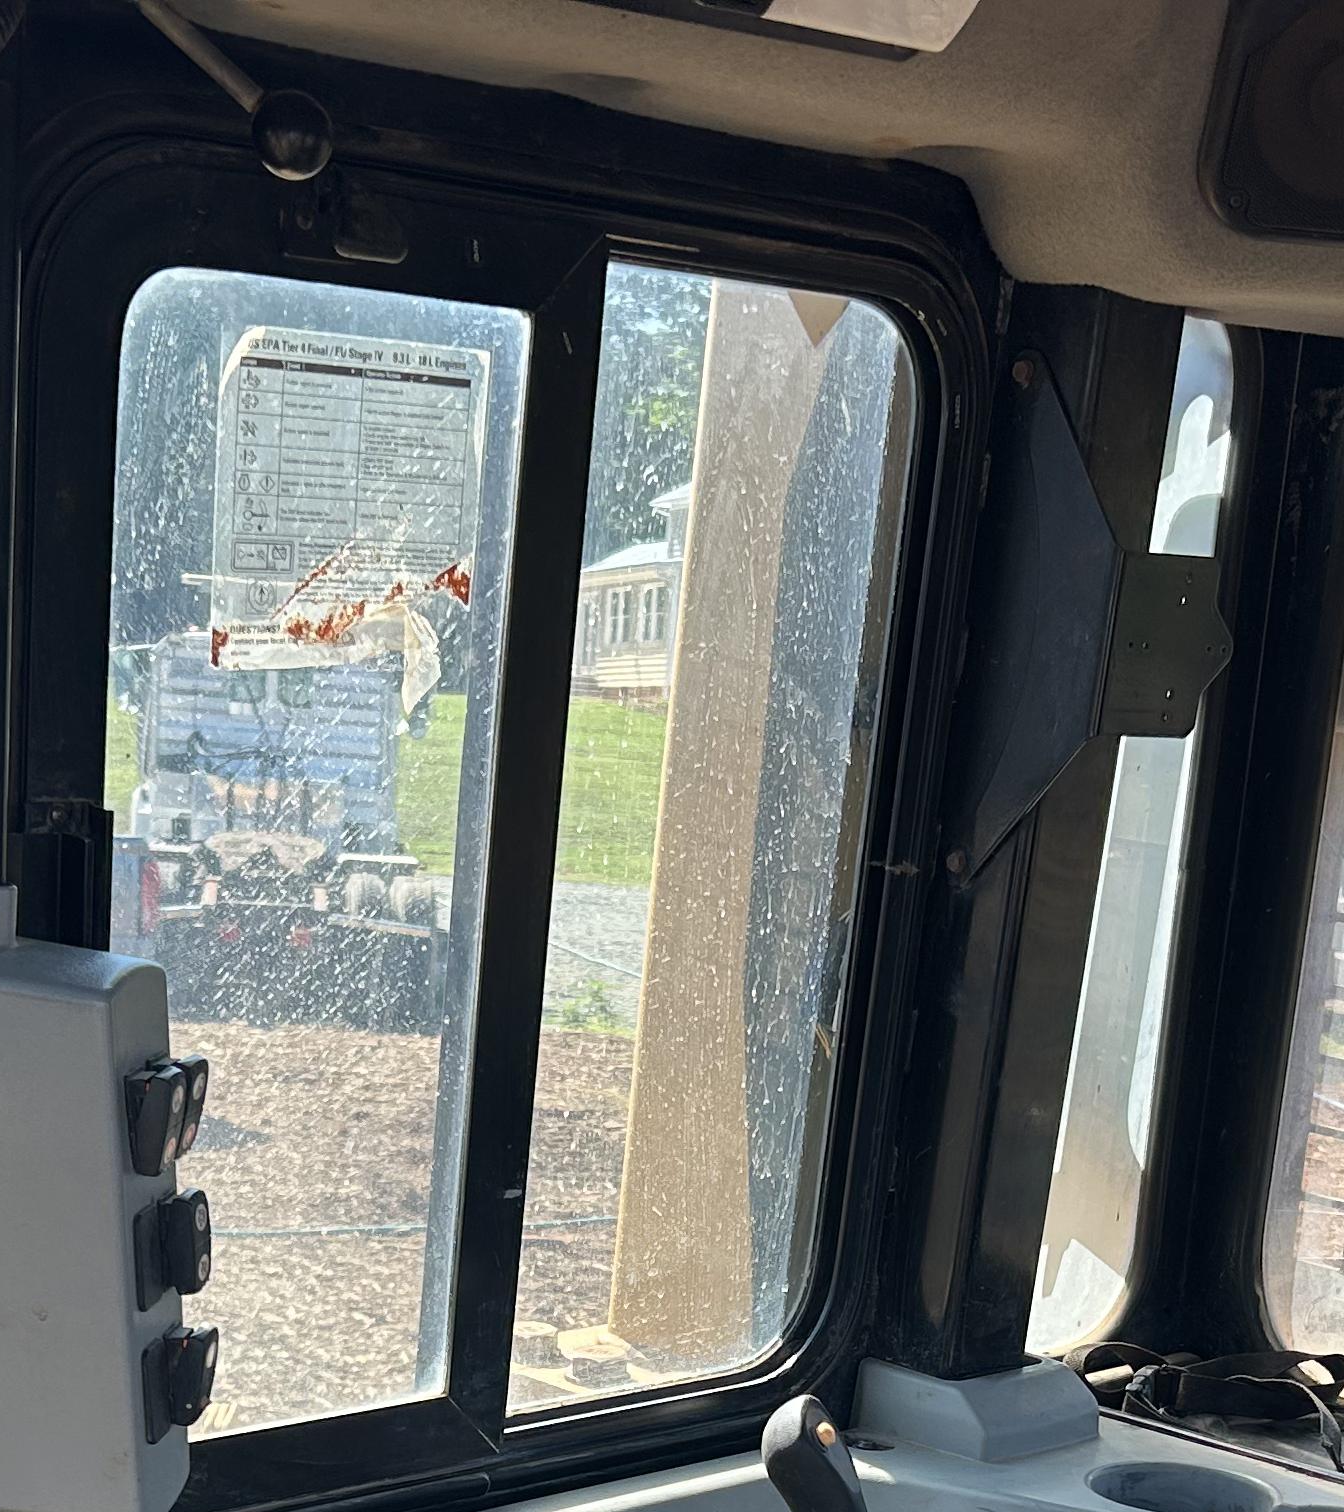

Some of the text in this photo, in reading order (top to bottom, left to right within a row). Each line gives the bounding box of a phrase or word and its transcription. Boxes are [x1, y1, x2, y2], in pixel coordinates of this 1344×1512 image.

[262, 339, 280, 351] EPA
[282, 341, 299, 353] Tier
[349, 348, 373, 363] Stage
